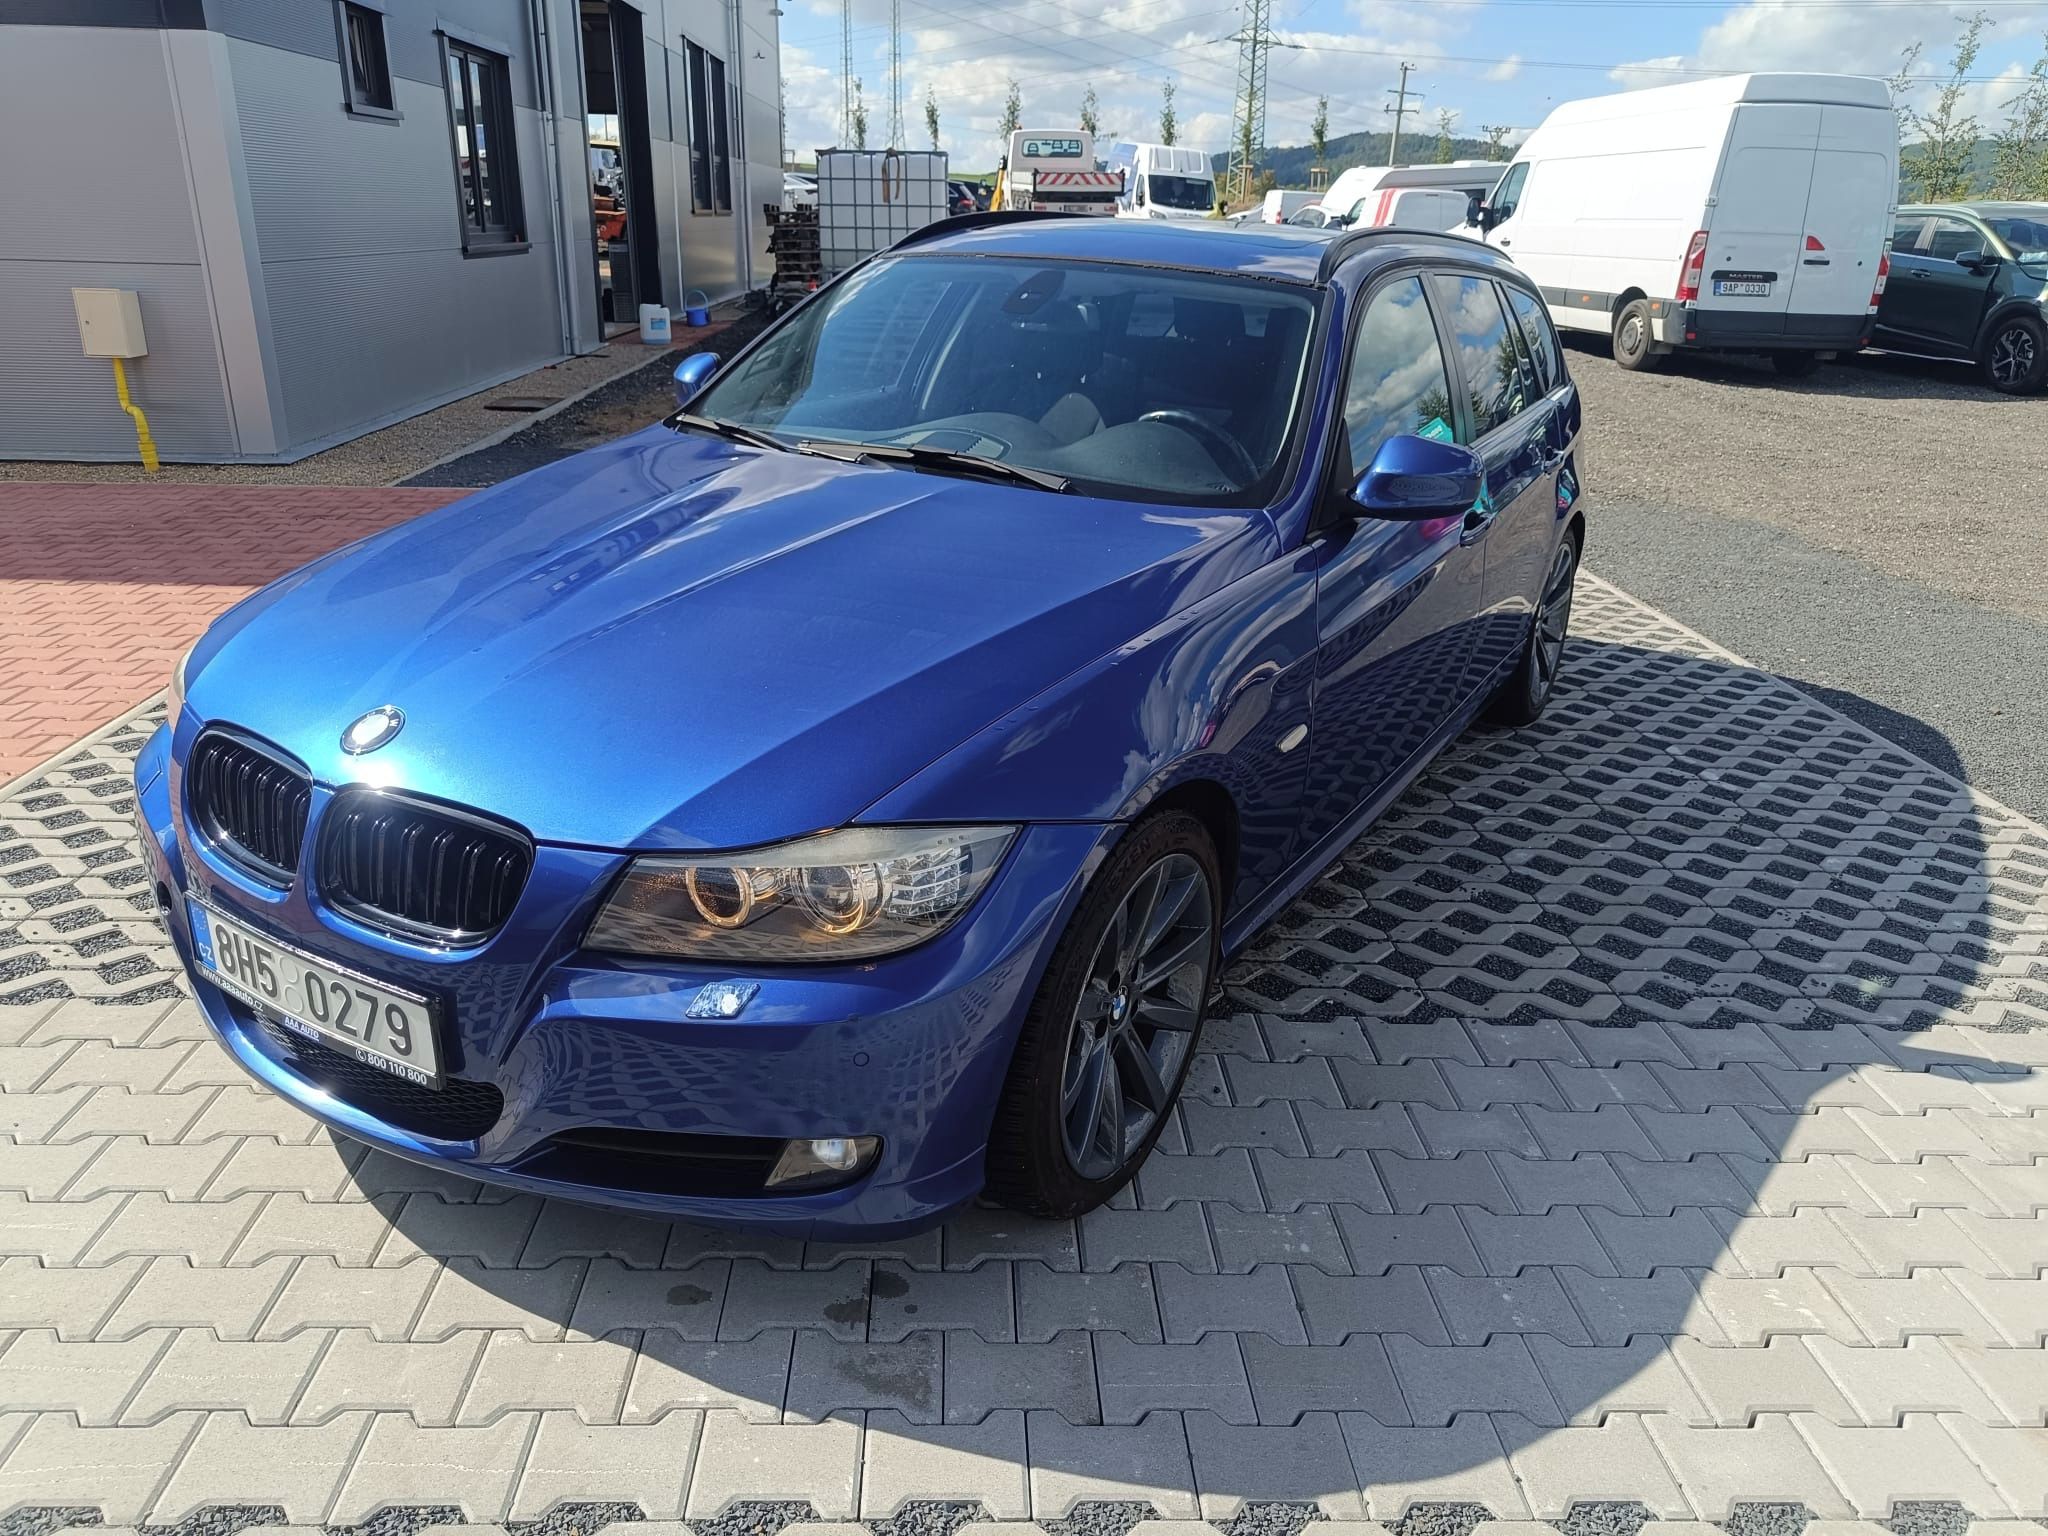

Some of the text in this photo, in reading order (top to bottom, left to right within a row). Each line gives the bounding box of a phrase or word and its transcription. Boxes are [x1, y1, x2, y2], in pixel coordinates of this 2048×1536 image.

[1722, 283, 1739, 293] 9AP
[1744, 284, 1766, 293] 0330
[198, 942, 215, 961] CZ
[201, 966, 264, 1012] www.aaaauto.cz
[215, 923, 412, 1056] 8H5 0279
[284, 1016, 320, 1040] AAA AUTO
[368, 1049, 427, 1085] 800 110 800
